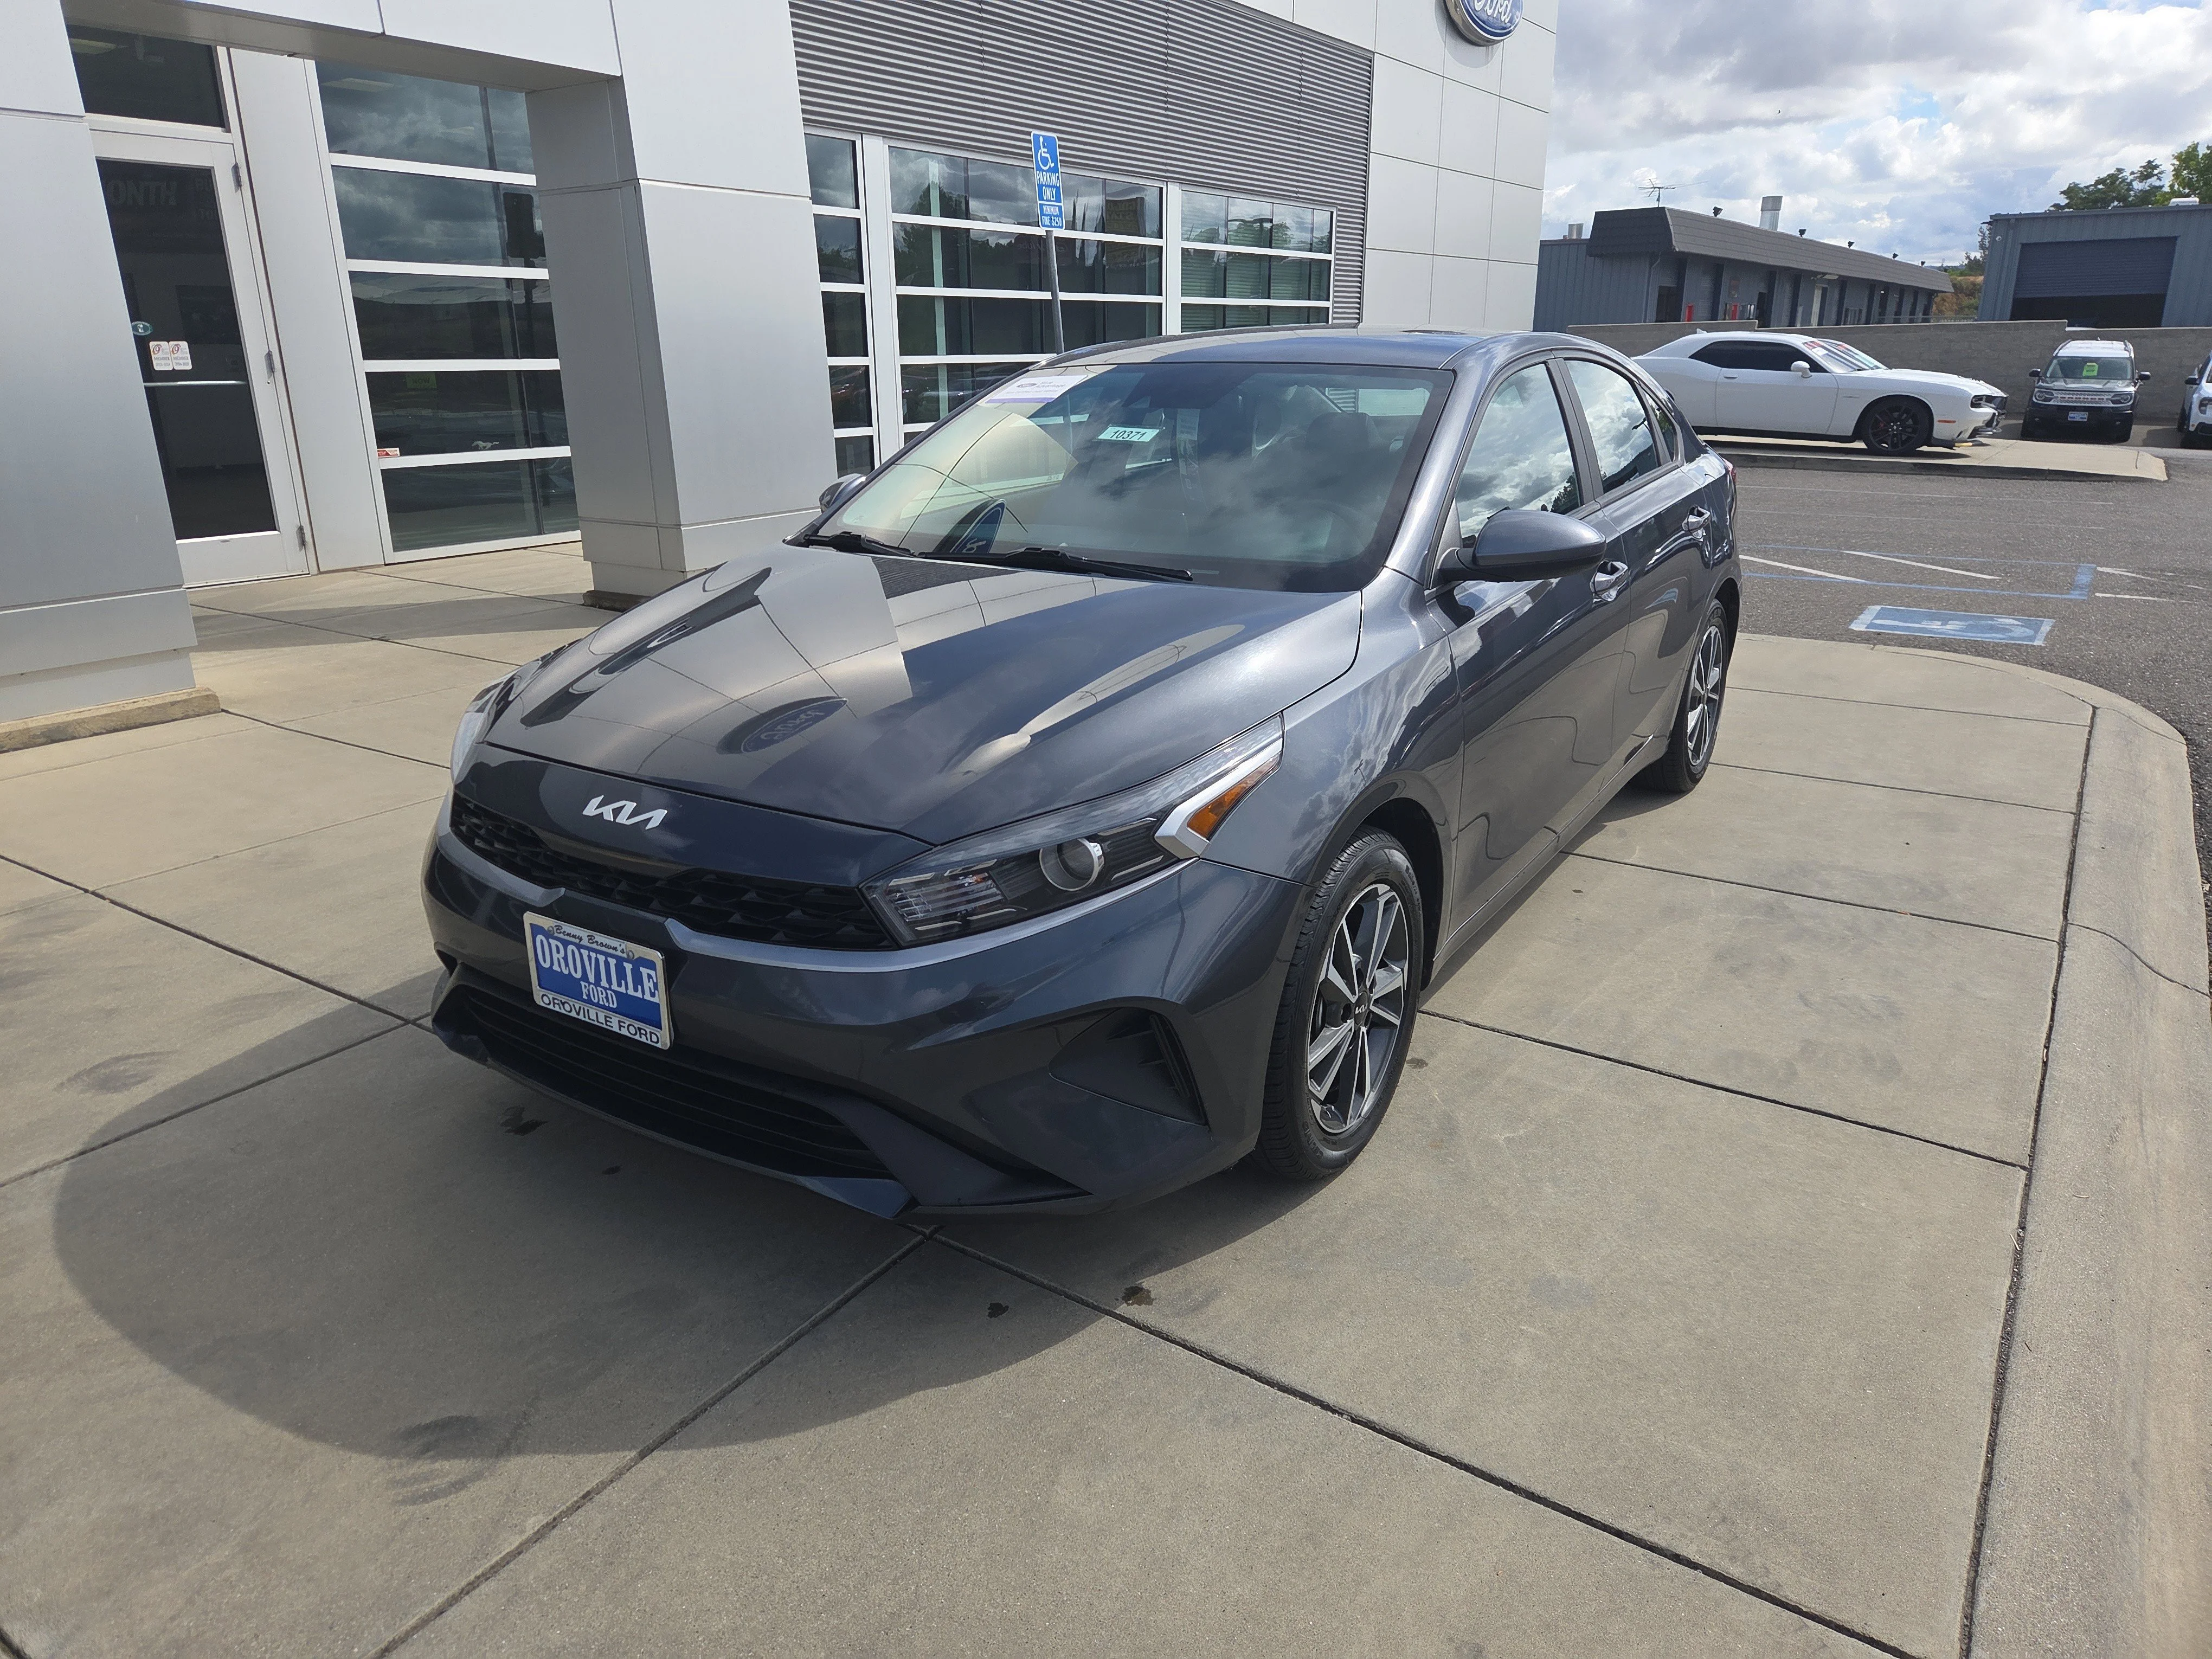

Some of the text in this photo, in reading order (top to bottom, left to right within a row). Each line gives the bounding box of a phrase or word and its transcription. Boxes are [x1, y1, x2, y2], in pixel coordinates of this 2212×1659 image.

[1036, 170, 1059, 187] PARKING
[1042, 186, 1056, 201] ONLY
[1041, 215, 1062, 227] FINE $250
[1110, 429, 1147, 440] 10371
[555, 924, 626, 954] Benny Brown's
[535, 934, 660, 1003] OROVILLE
[580, 981, 618, 1008] FORD
[541, 993, 660, 1044] OROVILLE FORD
